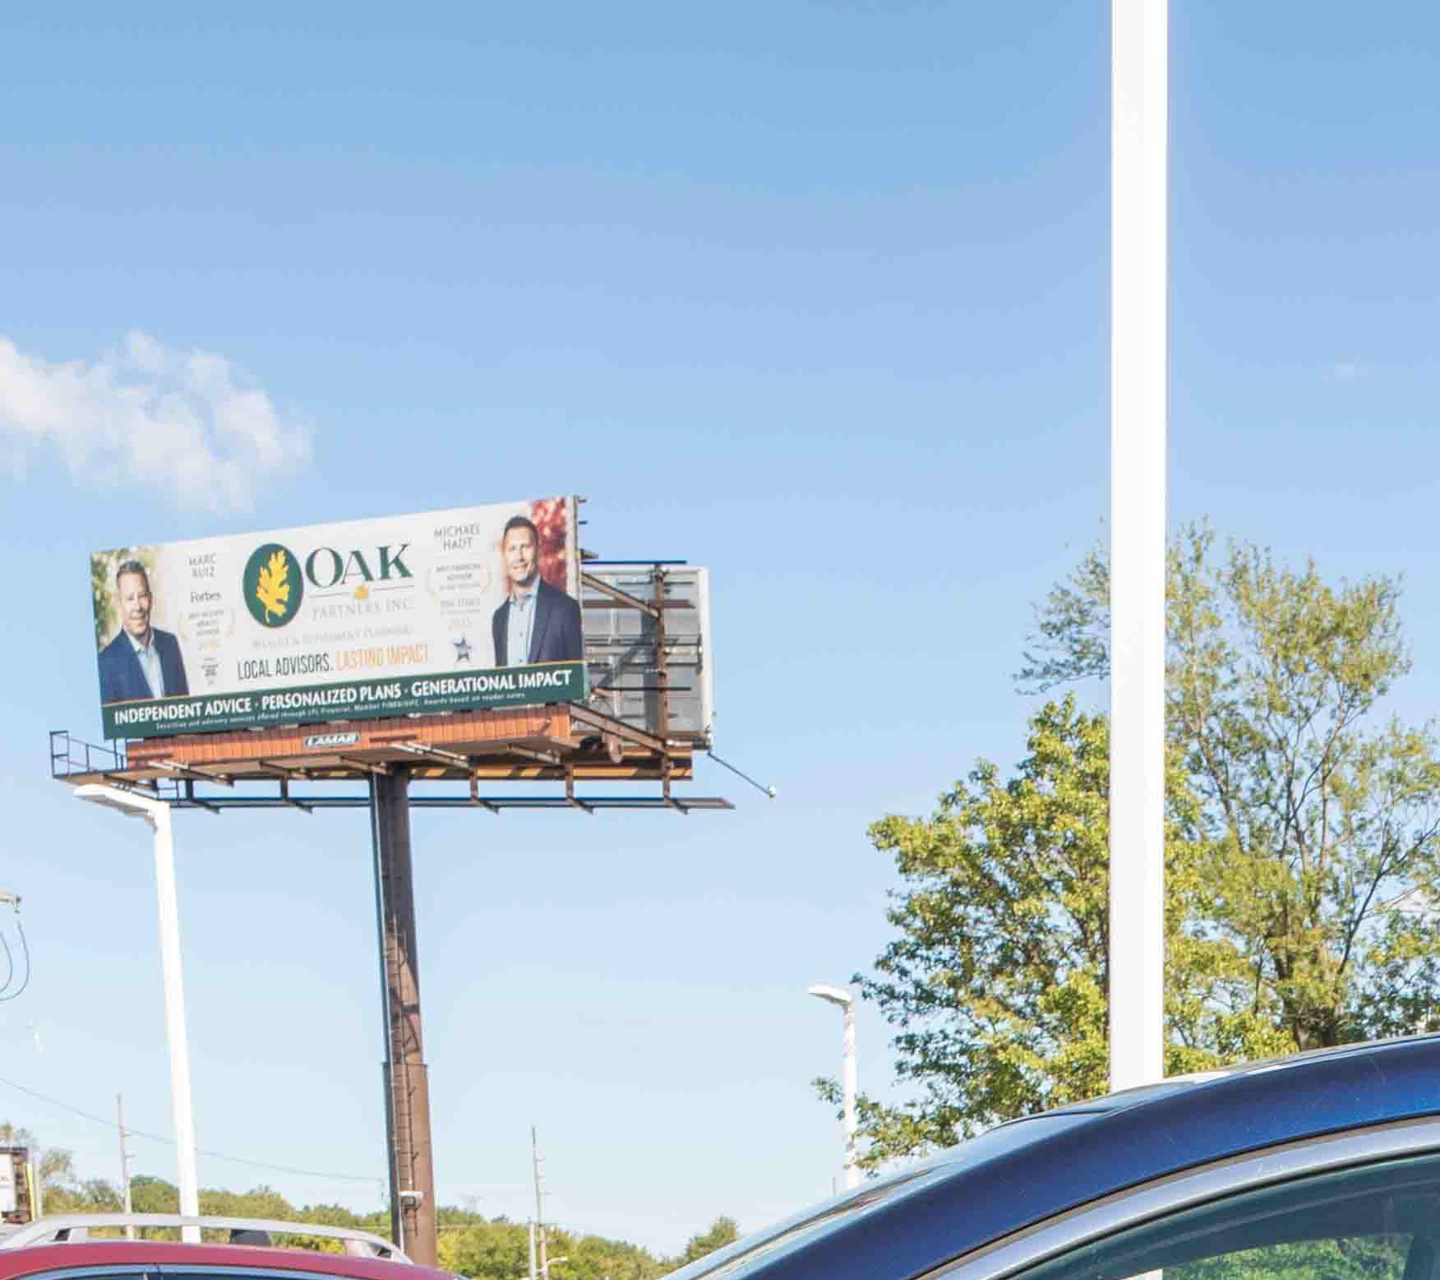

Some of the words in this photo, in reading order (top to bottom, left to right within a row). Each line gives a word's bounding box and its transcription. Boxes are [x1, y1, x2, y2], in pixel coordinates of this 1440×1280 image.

[305, 544, 414, 589] OAK
[190, 591, 222, 603] Forbes
[238, 657, 272, 681] LOCAL
[336, 647, 384, 671] LASTING
[387, 643, 428, 667] IMPACT
[115, 702, 203, 725] INDEPENDENT
[204, 698, 252, 716] ADVICE
[262, 688, 357, 710] PERSONALIZED
[360, 683, 401, 701] PLANS
[412, 676, 516, 697] GENERATIONAL
[518, 669, 572, 689] IMPACT
[307, 733, 358, 747] LAMAR
